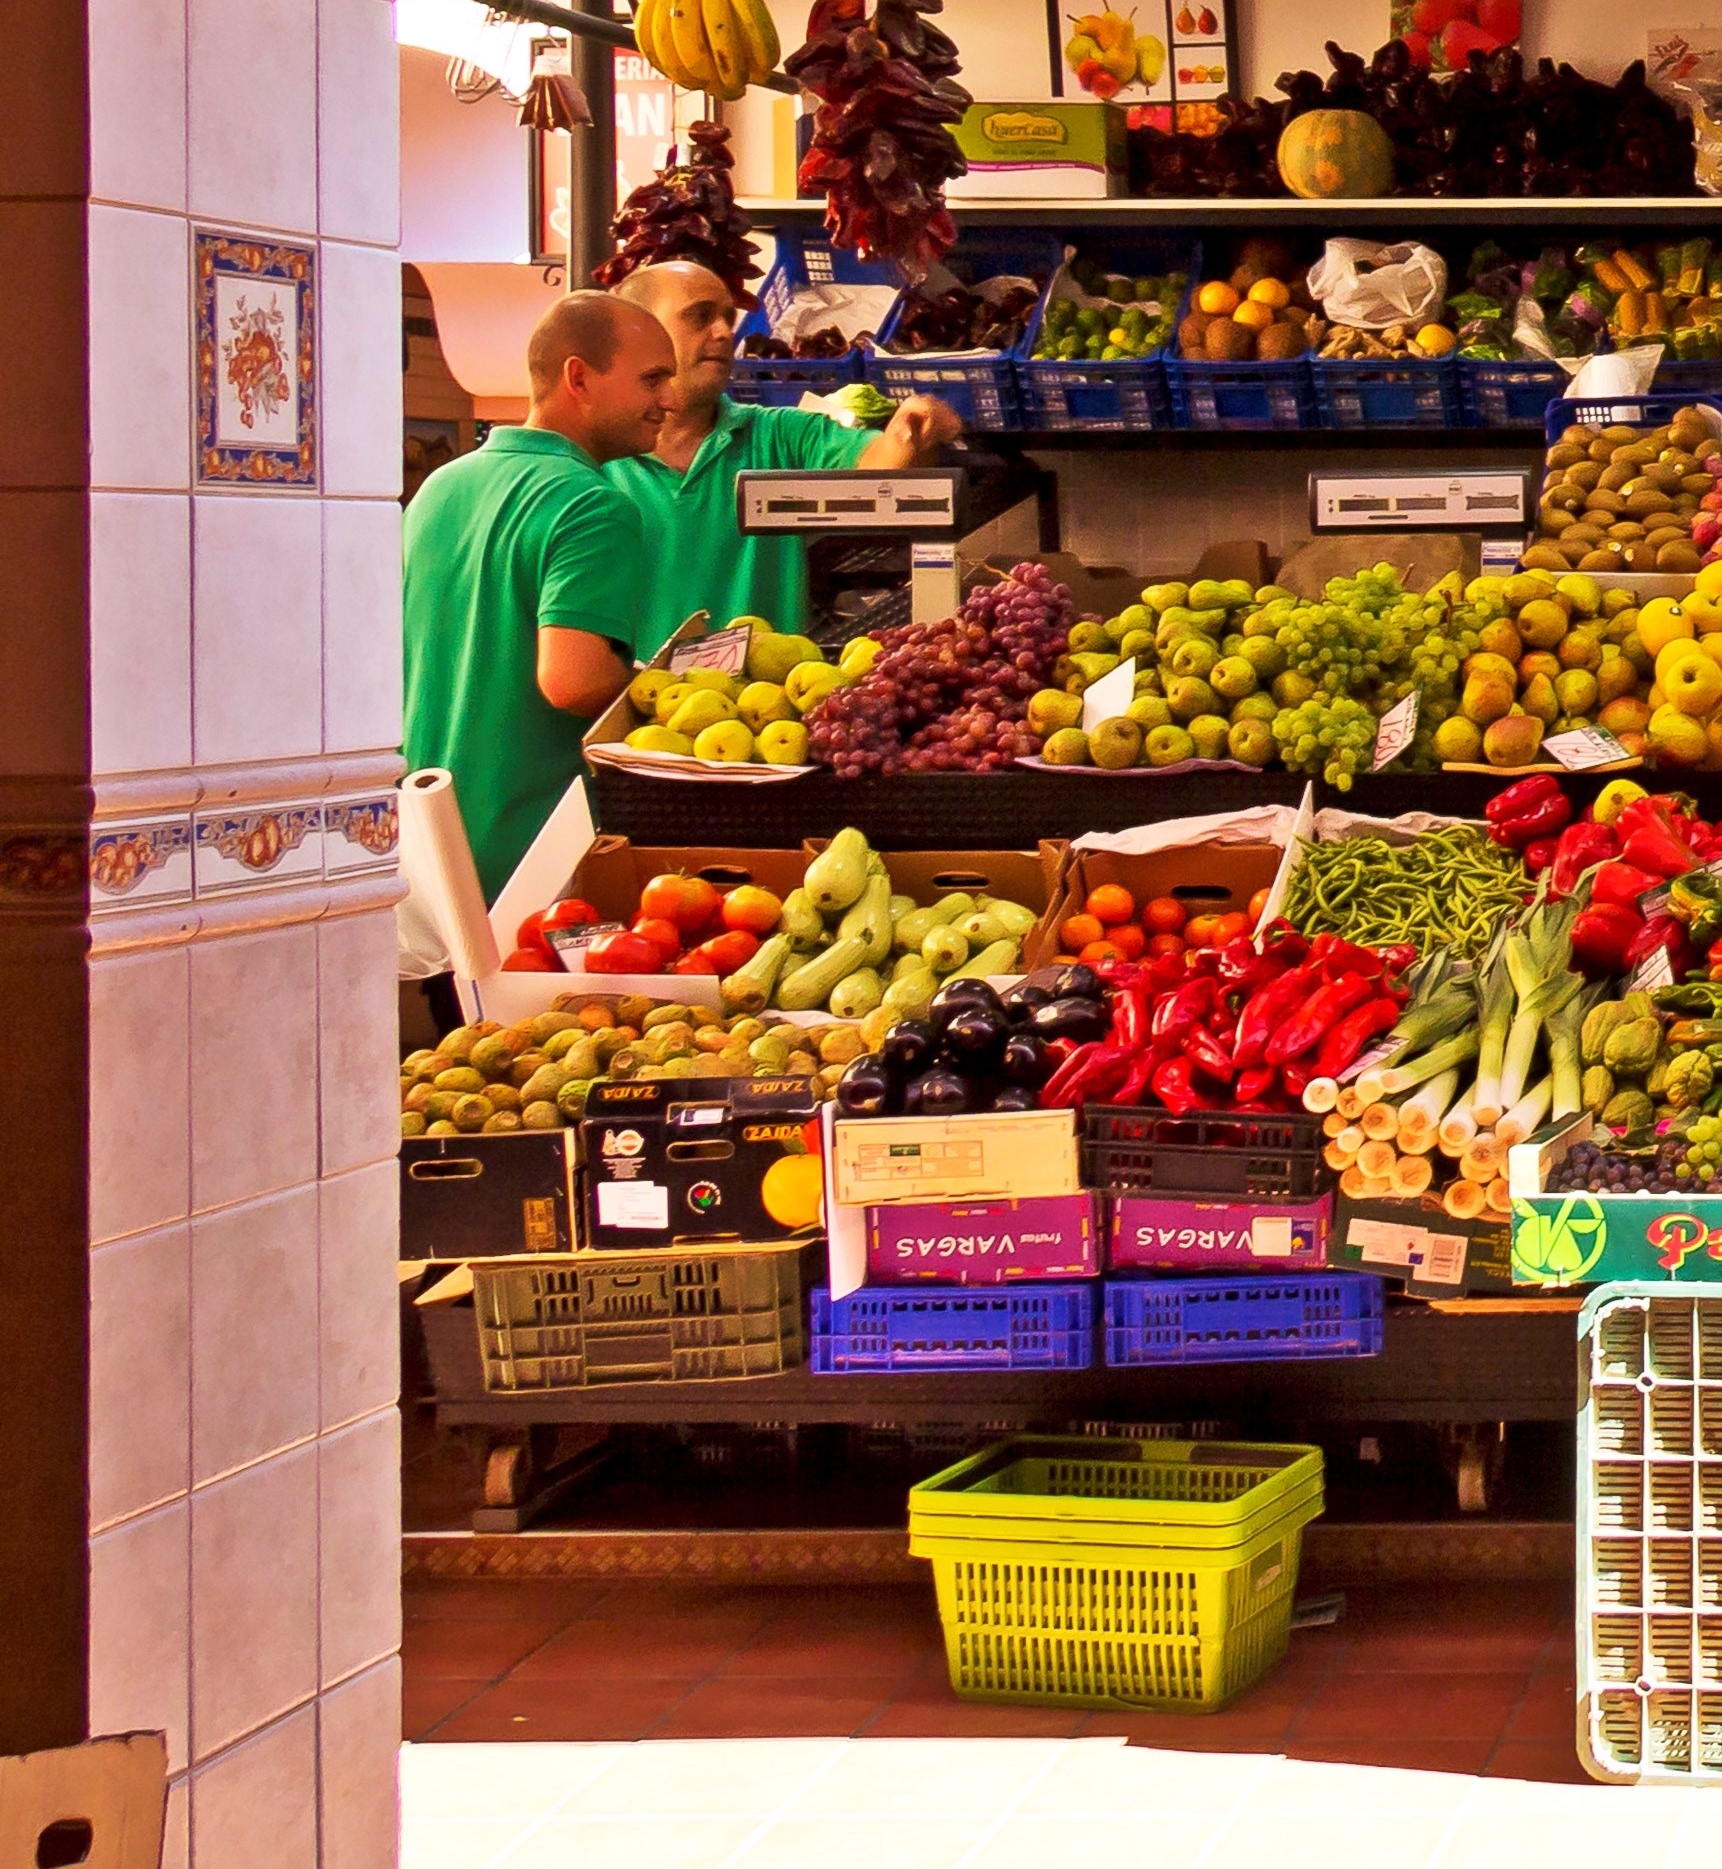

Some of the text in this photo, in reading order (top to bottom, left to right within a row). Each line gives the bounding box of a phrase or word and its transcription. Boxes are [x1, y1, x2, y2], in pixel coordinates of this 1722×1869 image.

[602, 1084, 654, 1100] ZAIDA
[748, 1125, 803, 1141] ZAIDA
[896, 1232, 1062, 1258] frutas VARGAS
